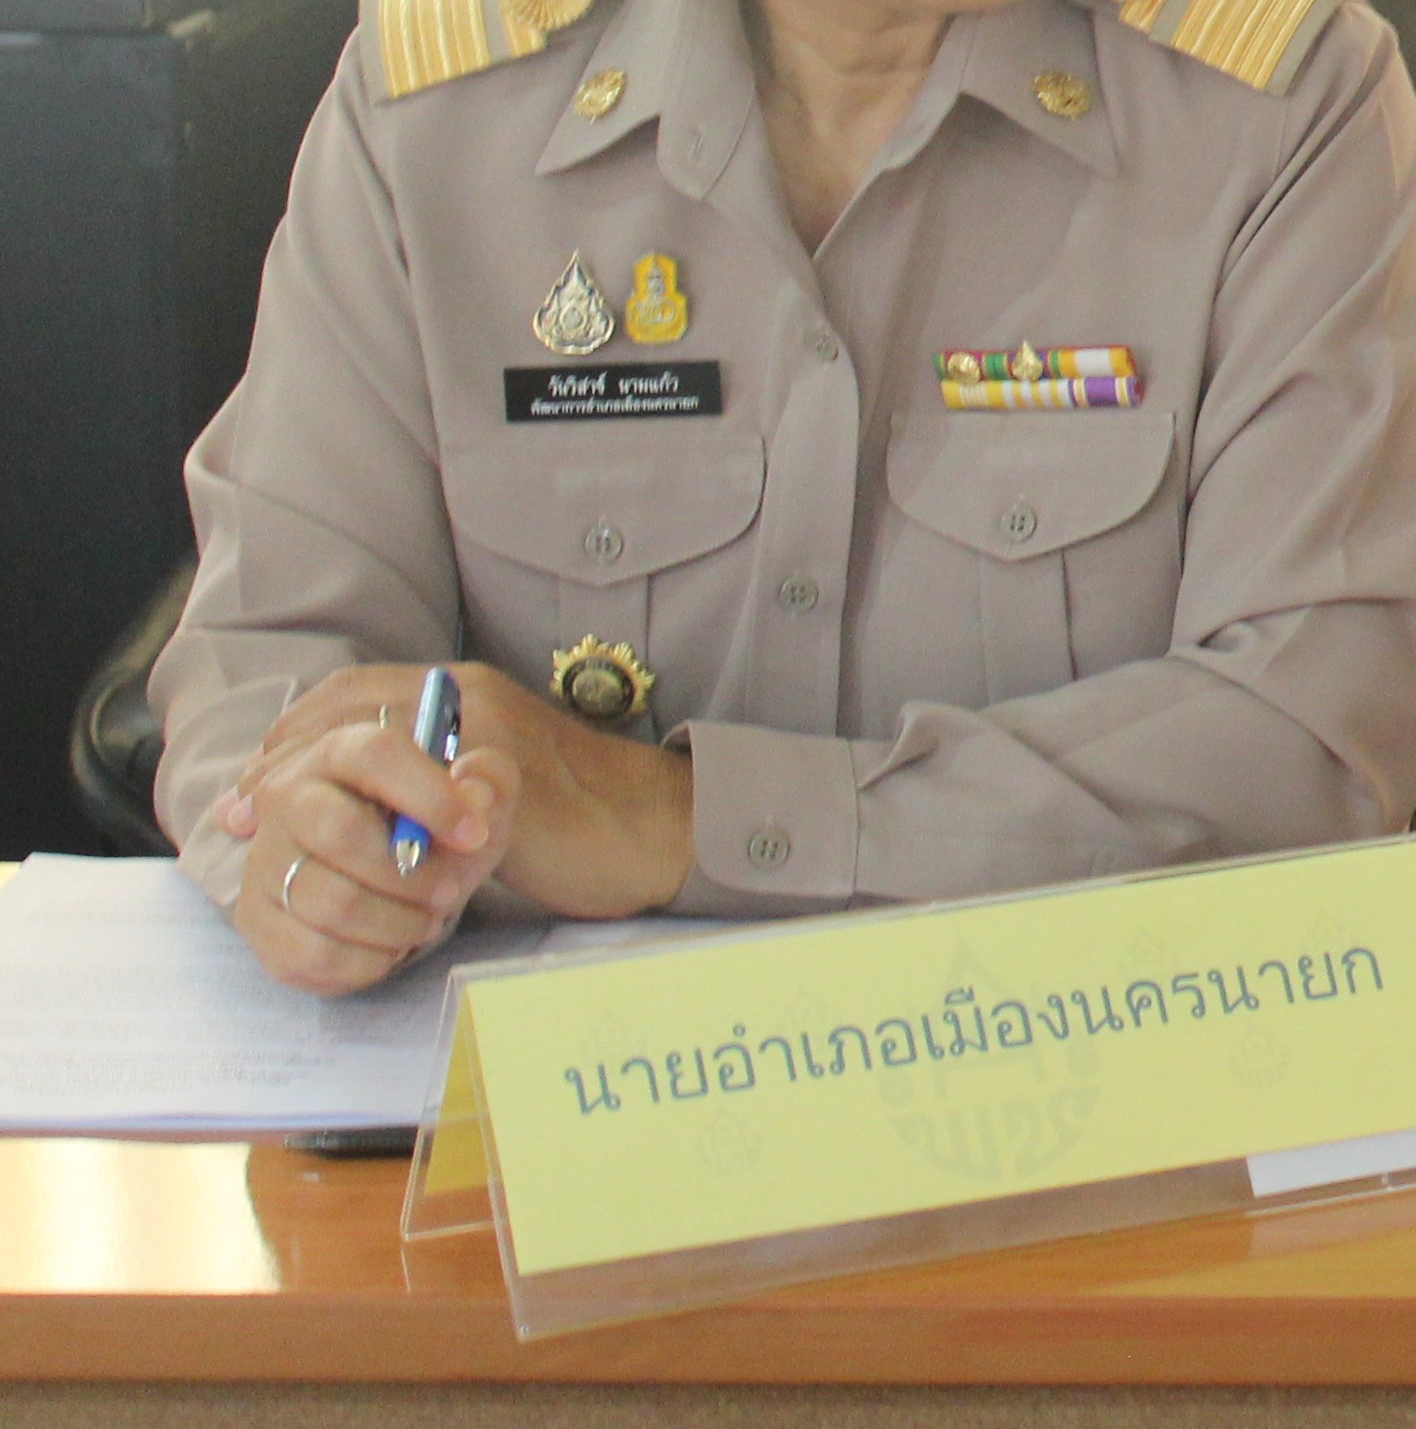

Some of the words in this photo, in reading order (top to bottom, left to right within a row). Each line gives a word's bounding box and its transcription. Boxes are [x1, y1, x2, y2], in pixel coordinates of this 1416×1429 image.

[565, 940, 1385, 1116] นายอำเภอเมืองนครนายก
